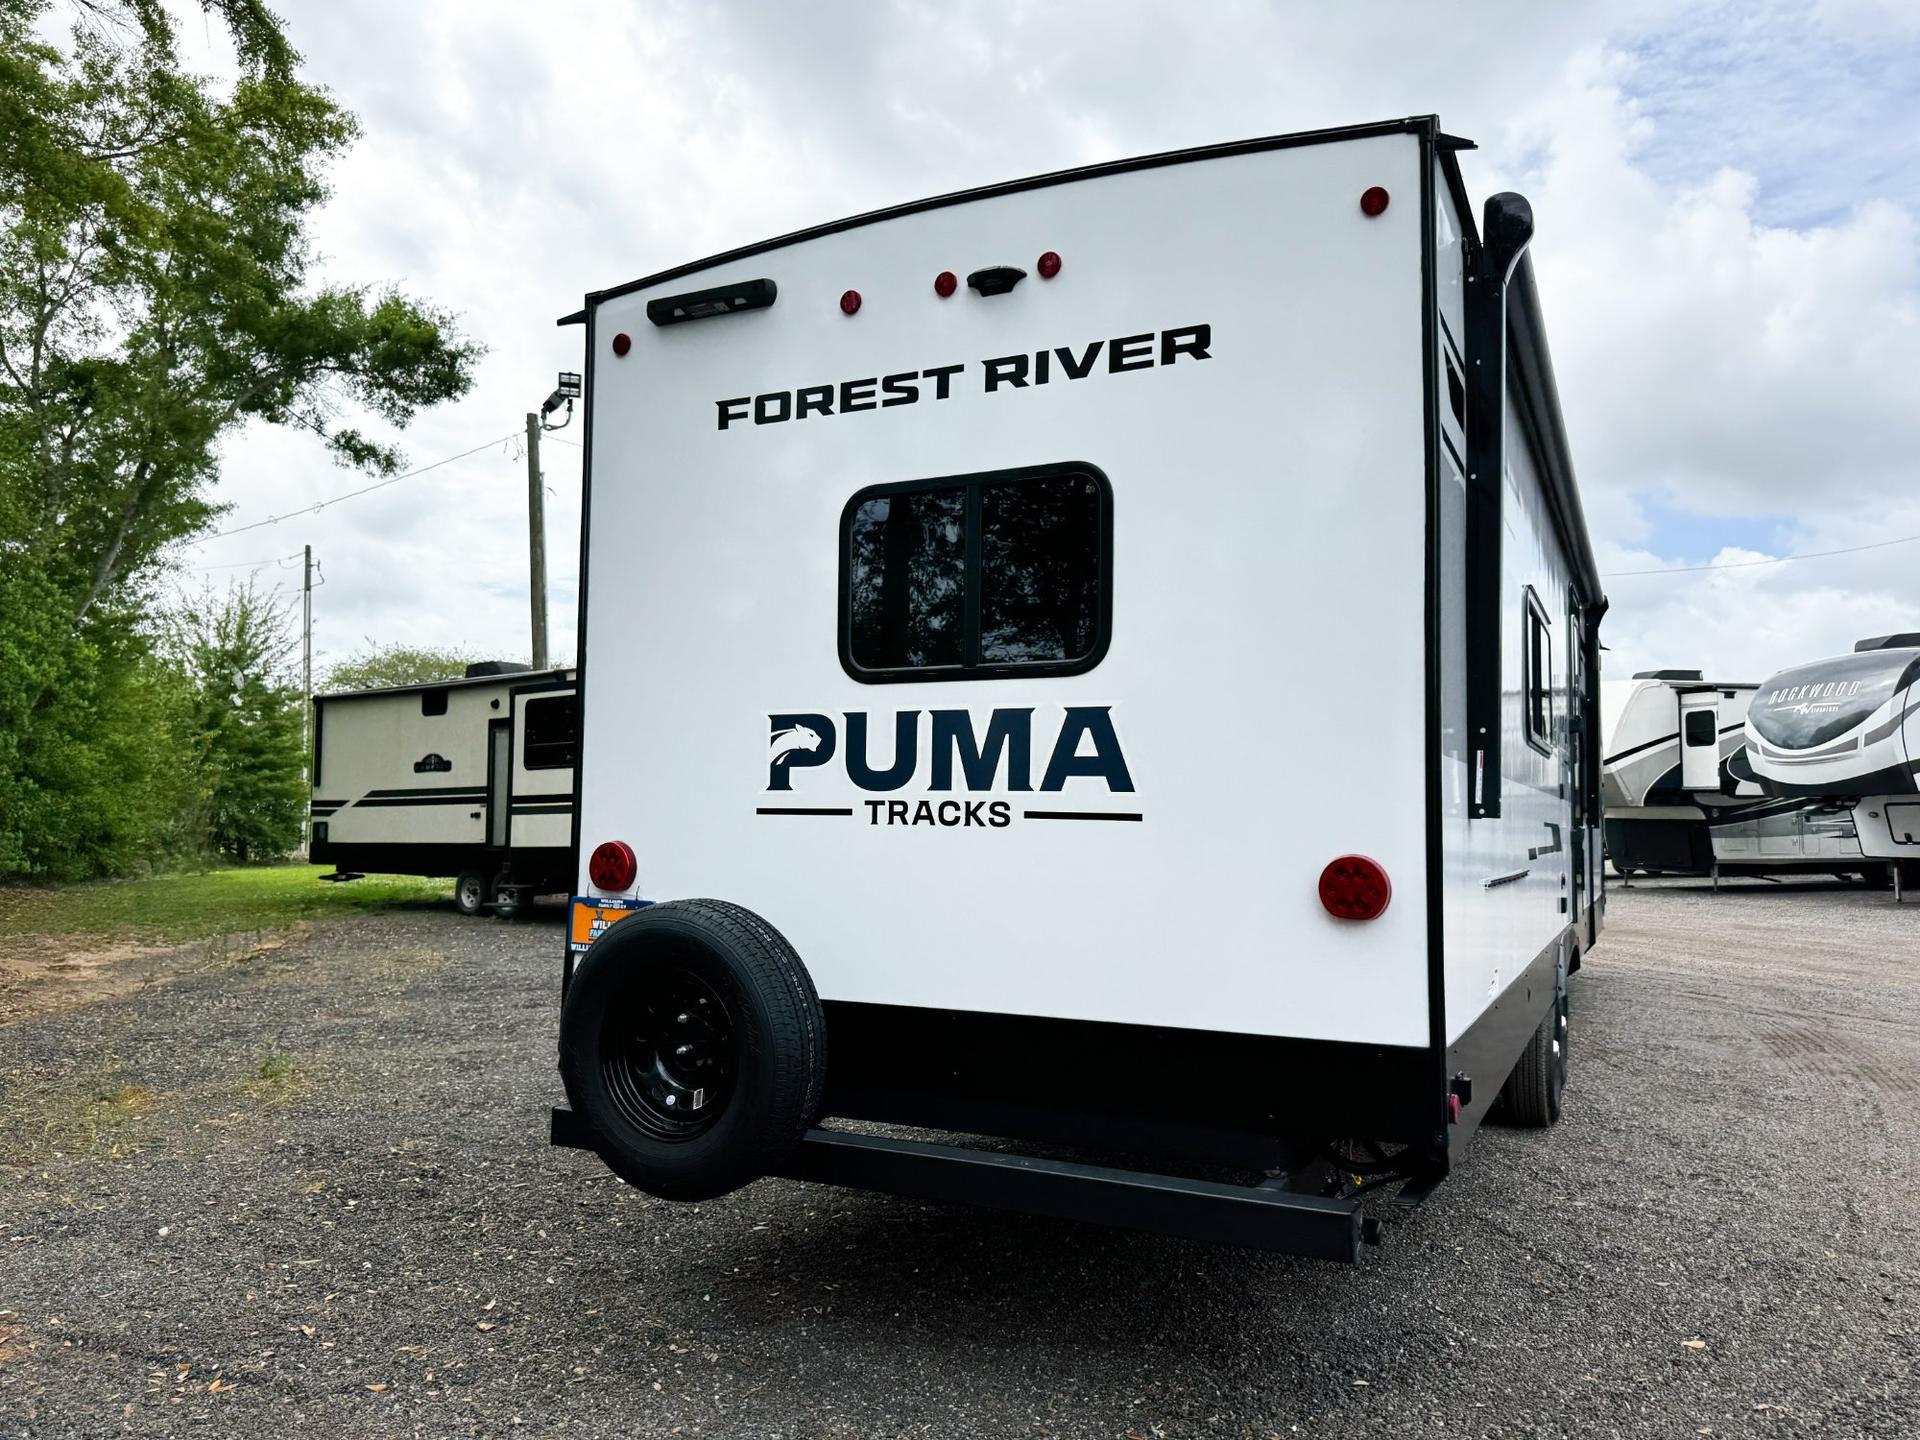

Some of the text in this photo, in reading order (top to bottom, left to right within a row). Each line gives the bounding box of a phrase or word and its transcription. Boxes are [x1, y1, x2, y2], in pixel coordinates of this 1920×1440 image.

[715, 323, 1213, 431] FOREST RIVER
[1768, 680, 1861, 705] ROCKWOOD
[765, 705, 1136, 793] PUMA
[864, 800, 1011, 828] TRACKS
